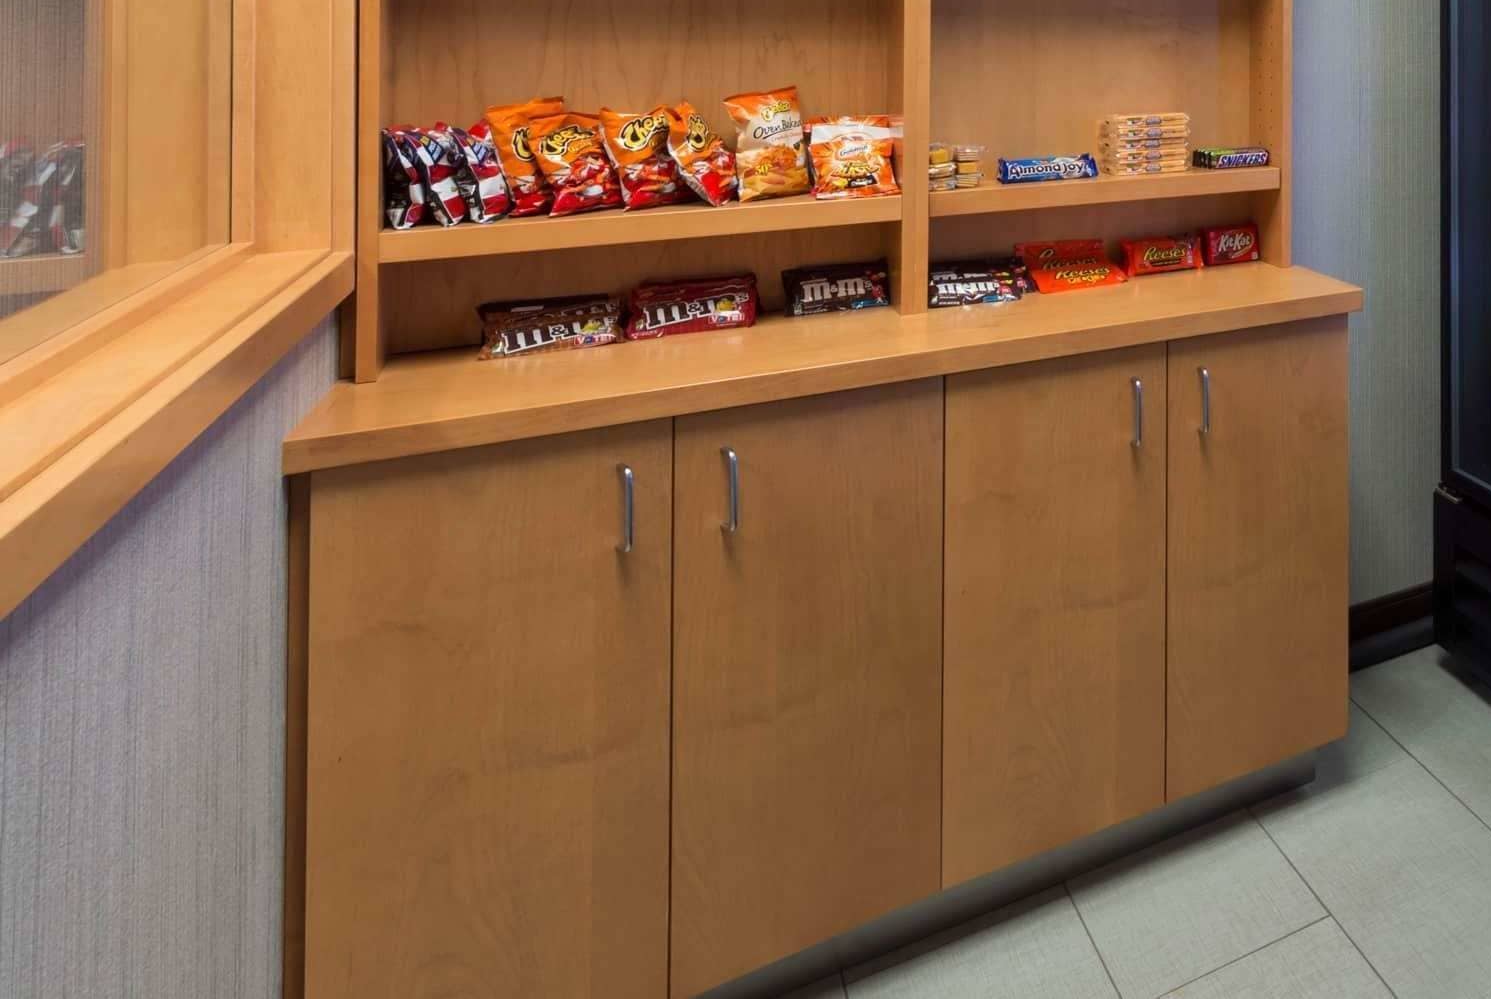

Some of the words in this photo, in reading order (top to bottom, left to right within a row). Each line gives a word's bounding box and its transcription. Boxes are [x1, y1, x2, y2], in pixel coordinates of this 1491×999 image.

[753, 124, 781, 139] Oven
[1218, 153, 1267, 169] SNICKERS
[1009, 163, 1061, 177] Almond
